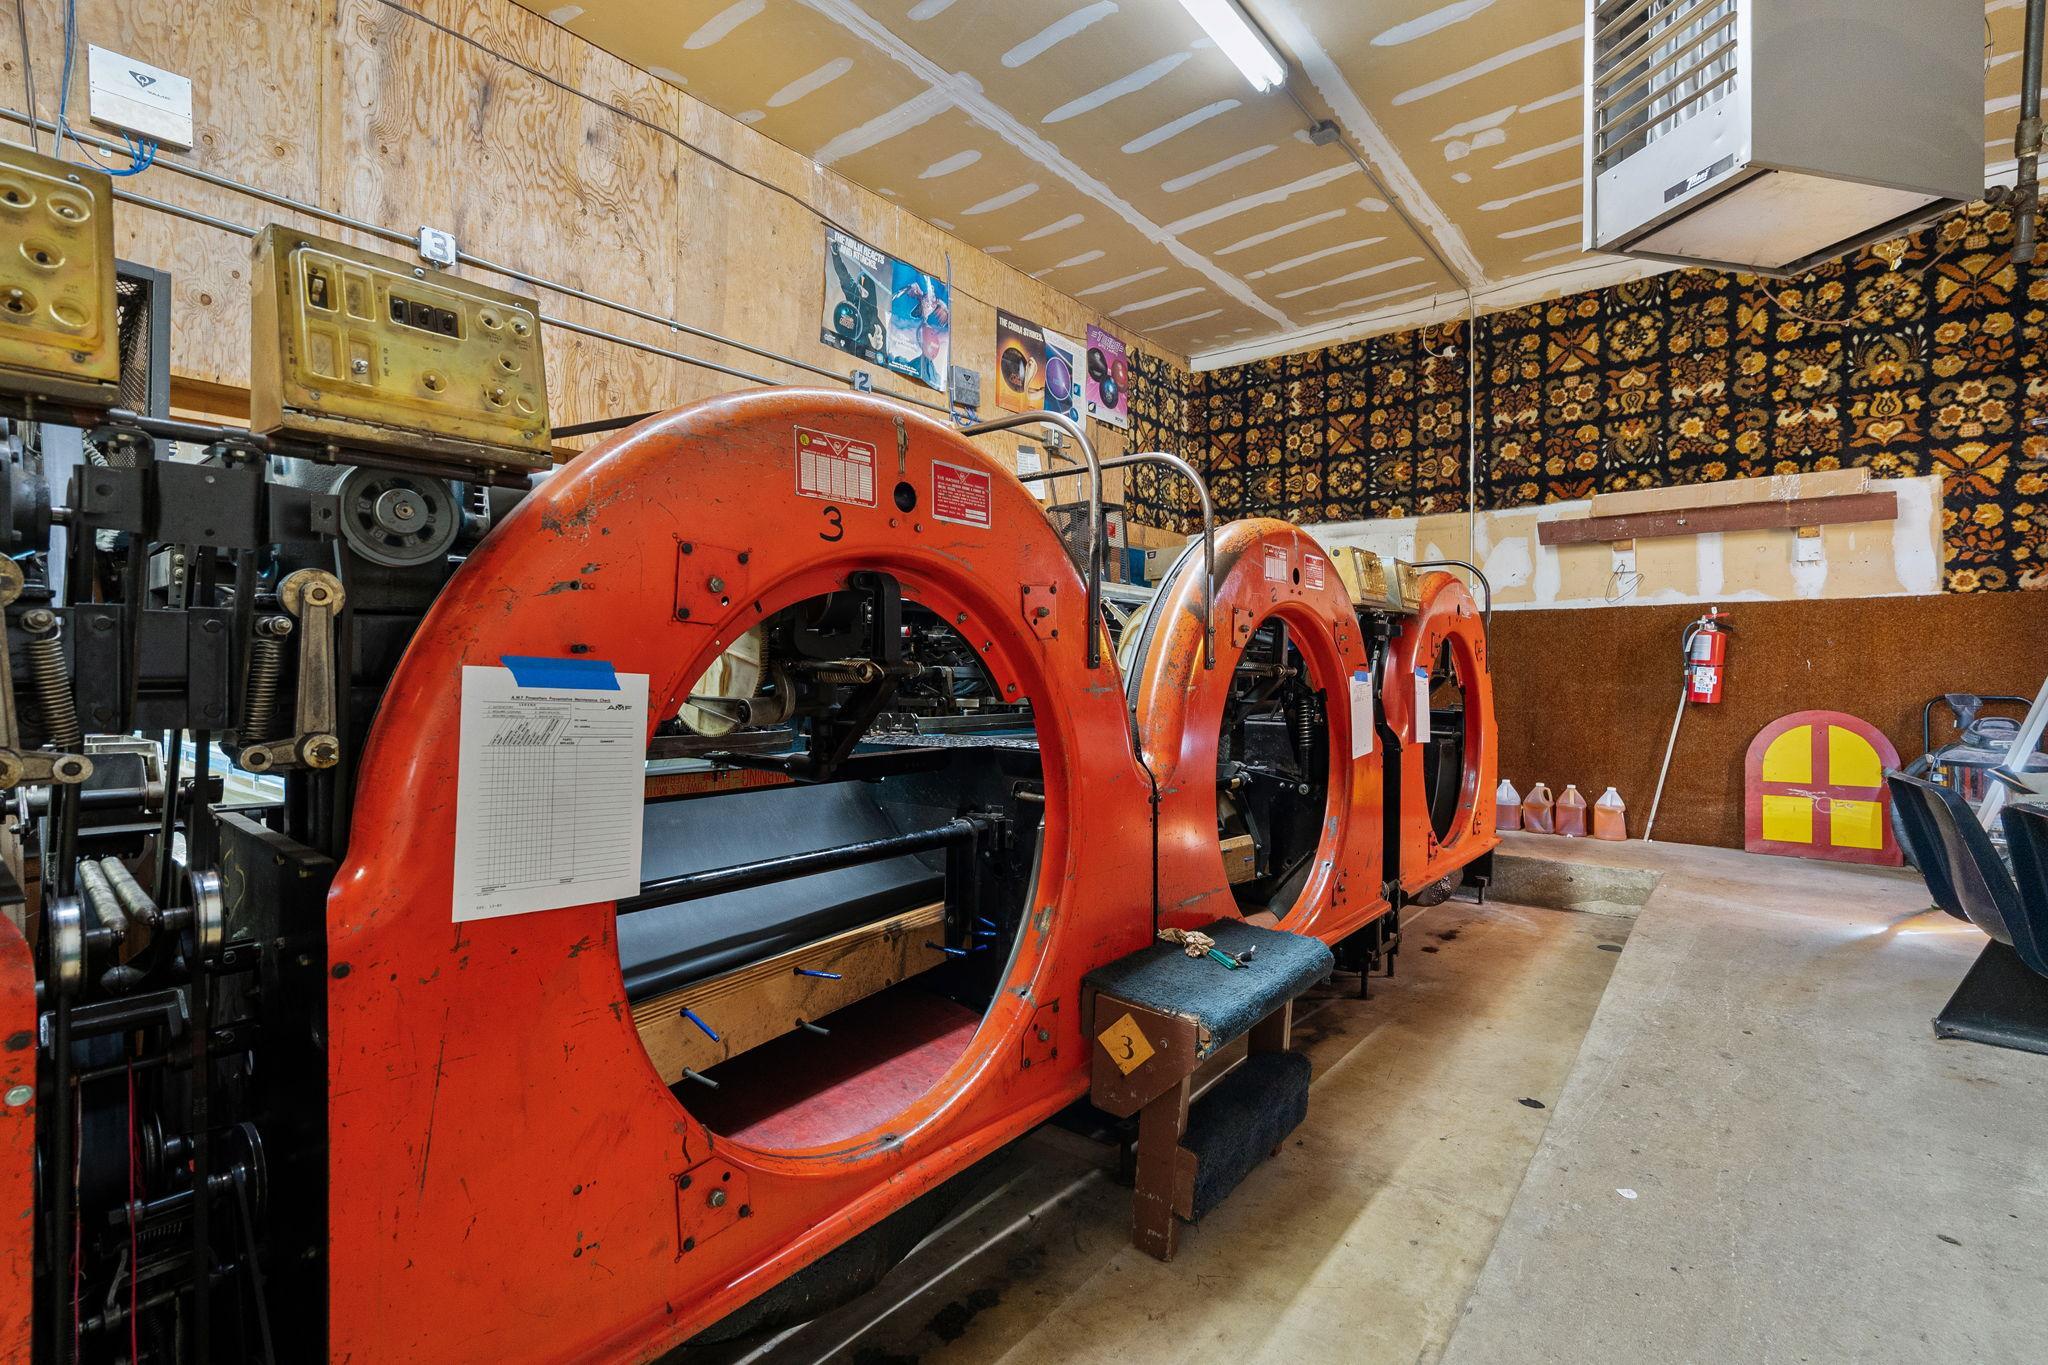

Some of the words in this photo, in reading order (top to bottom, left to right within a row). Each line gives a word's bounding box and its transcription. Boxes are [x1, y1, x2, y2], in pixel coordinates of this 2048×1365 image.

[430, 232, 449, 260] 3
[834, 231, 846, 245] THE
[863, 247, 885, 264] REACTS
[999, 316, 1008, 328] THE
[1008, 320, 1023, 335] COBRA
[858, 371, 870, 392] 2
[820, 506, 844, 541] 3
[1271, 587, 1278, 602] 2
[1120, 1035, 1135, 1060] 3
